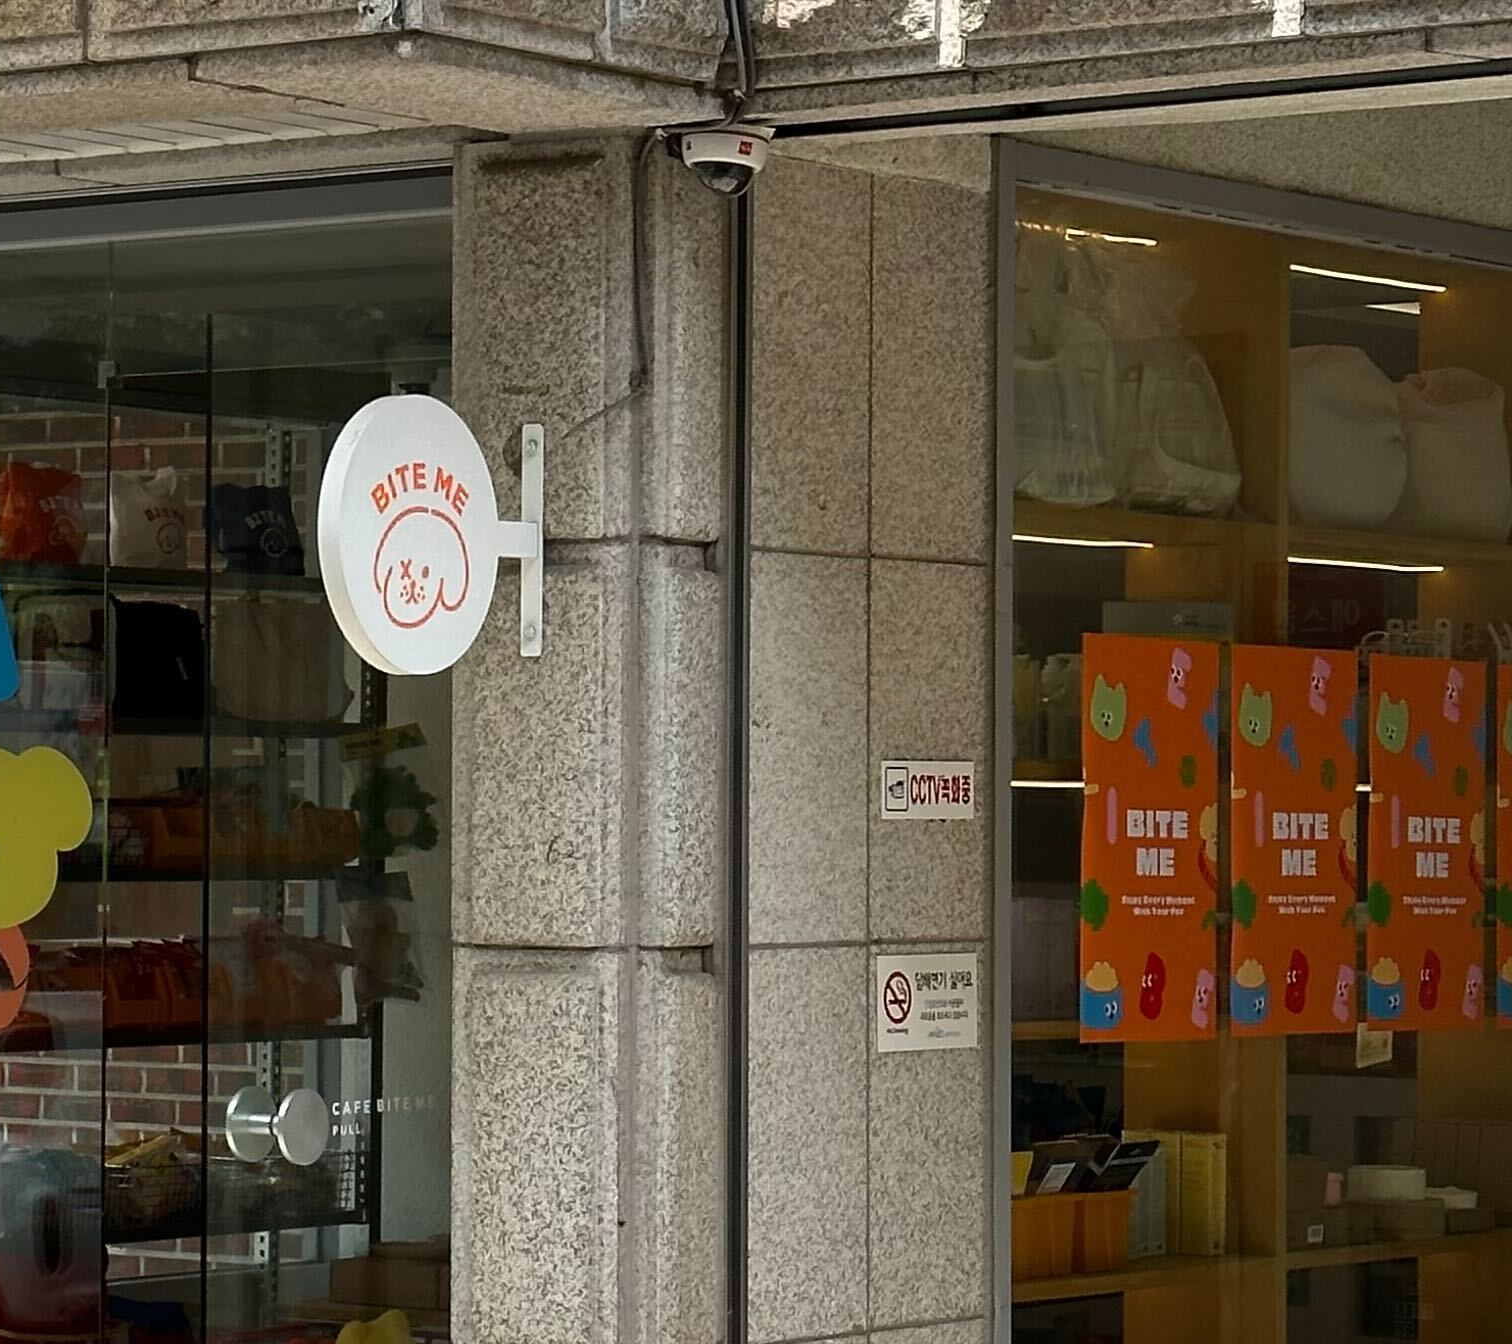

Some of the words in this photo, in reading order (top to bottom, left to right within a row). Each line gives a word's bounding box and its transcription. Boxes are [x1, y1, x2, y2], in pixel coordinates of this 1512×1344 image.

[370, 462, 427, 516] BITE
[433, 465, 470, 517] ME
[1126, 809, 1188, 839] BITE
[1272, 813, 1329, 840] BITE
[1407, 816, 1462, 844] BITE
[1136, 847, 1175, 877] ME
[1281, 849, 1317, 877] ME
[1415, 852, 1449, 878] ME
[331, 1099, 372, 1116] CAFE
[332, 1122, 361, 1137] PULL
